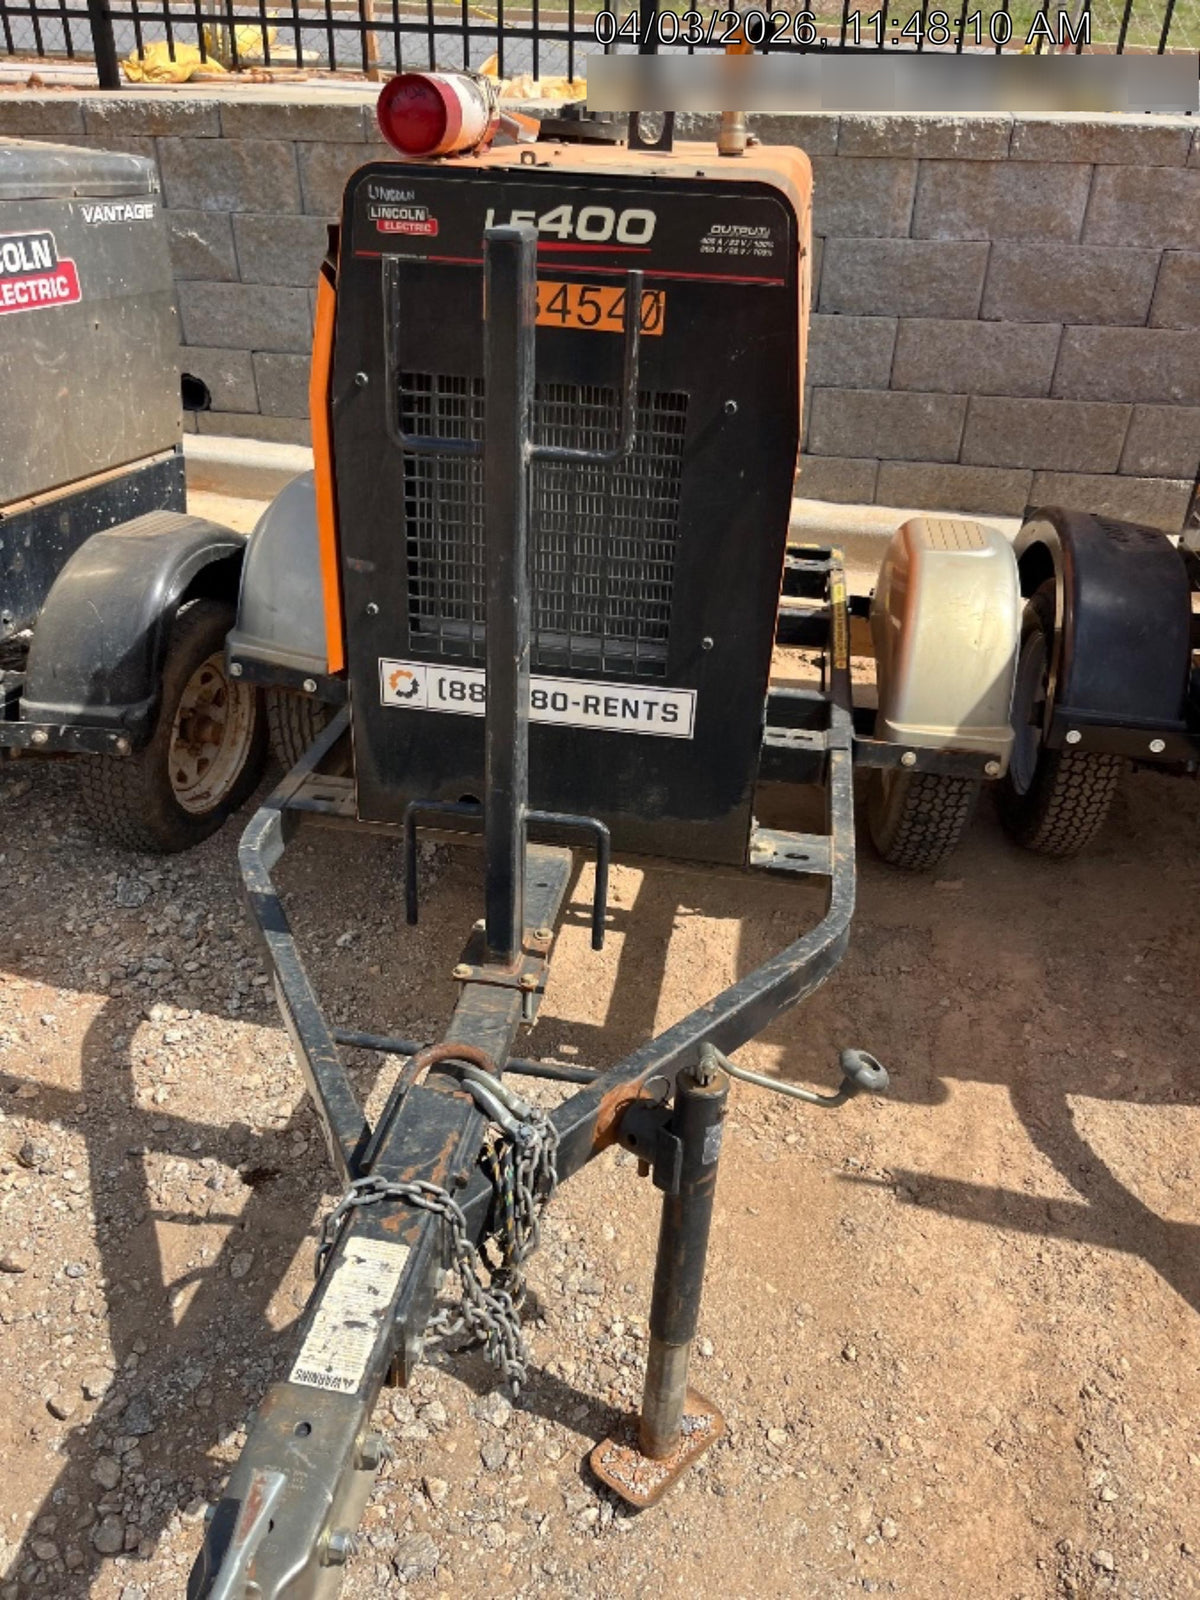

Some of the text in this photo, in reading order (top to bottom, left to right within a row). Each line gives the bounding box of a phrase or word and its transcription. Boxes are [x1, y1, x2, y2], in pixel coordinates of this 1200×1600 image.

[81, 204, 154, 223] VANTAGE
[370, 206, 426, 221] LINCOLN
[384, 220, 433, 233] ELECTRIC
[710, 225, 768, 237] OUTPUT
[0, 239, 53, 275] OLN
[0, 276, 70, 307] ECTRIC
[535, 284, 662, 332] 4540
[531, 689, 679, 722] 80-RENTS
